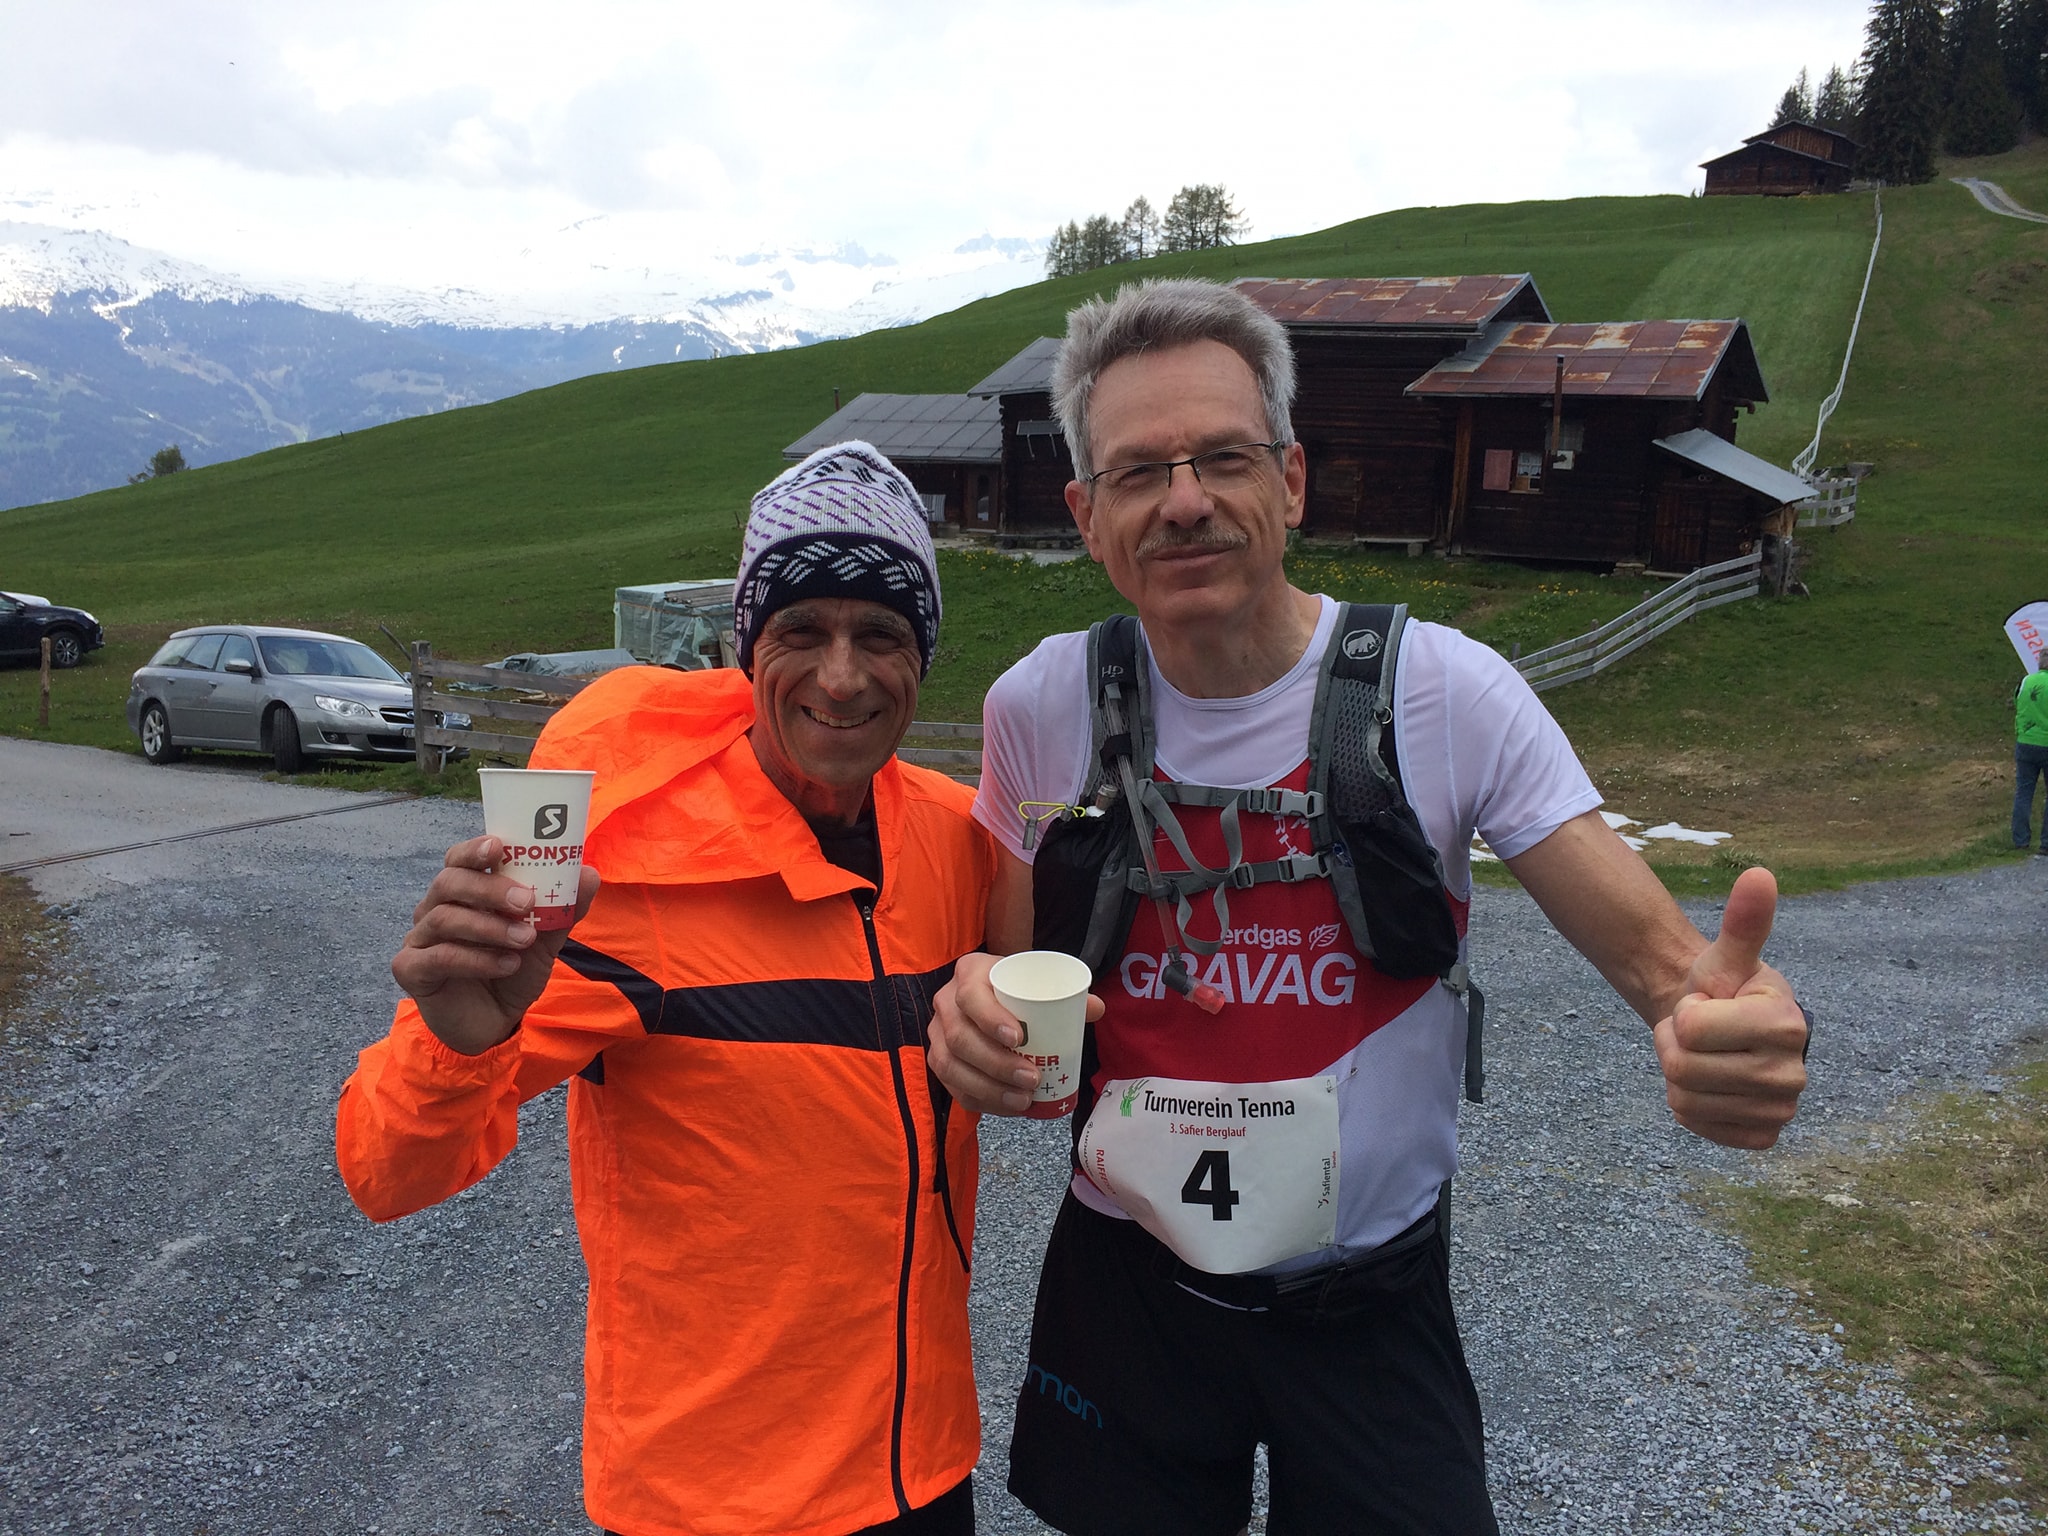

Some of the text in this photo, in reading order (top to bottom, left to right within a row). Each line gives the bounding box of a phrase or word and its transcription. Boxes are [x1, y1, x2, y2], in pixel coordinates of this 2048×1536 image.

[1221, 924, 1302, 950] erdgas
[1144, 1090, 1295, 1118] Turnverein Tenna
[1170, 1123, 1247, 1139] 3. Safier Berglauf
[1181, 1150, 1240, 1221] 4
[1322, 1158, 1331, 1197] Safiental
